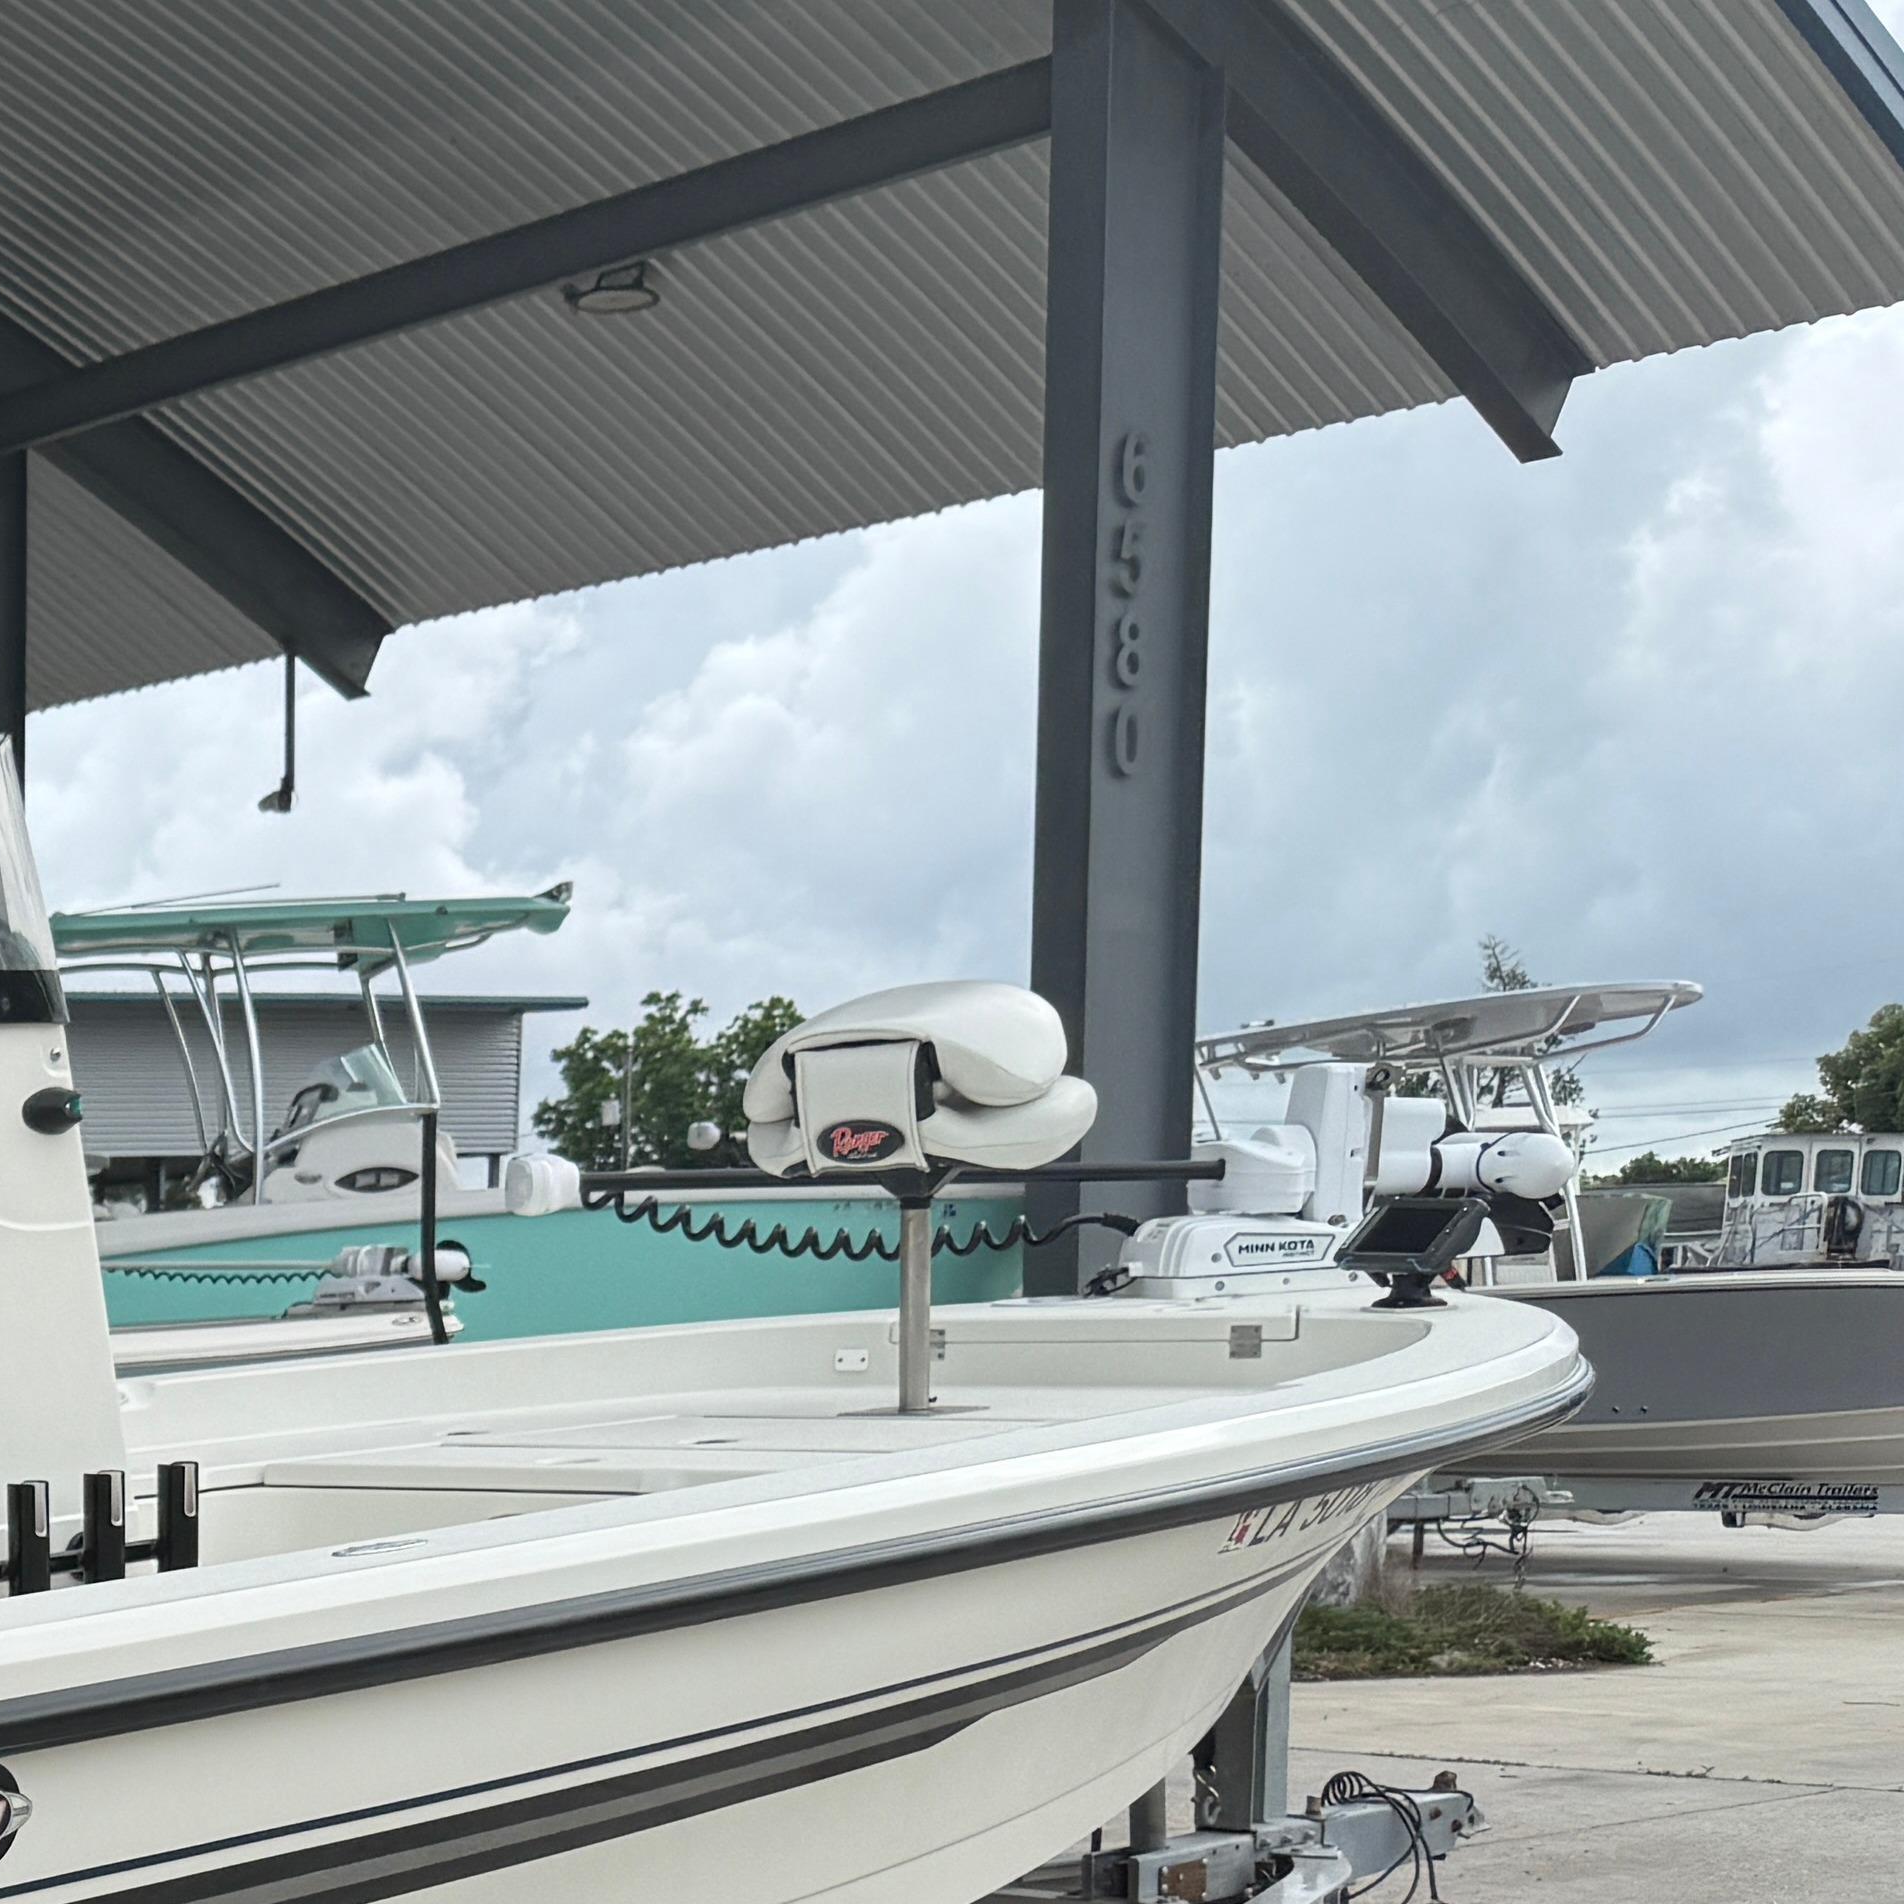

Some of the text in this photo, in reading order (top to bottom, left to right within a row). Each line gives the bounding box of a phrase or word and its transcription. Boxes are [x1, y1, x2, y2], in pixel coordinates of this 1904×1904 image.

[1111, 430, 1151, 777] 6580
[831, 1127, 889, 1157] Ranger
[1238, 1239, 1315, 1255] MINN KOTA
